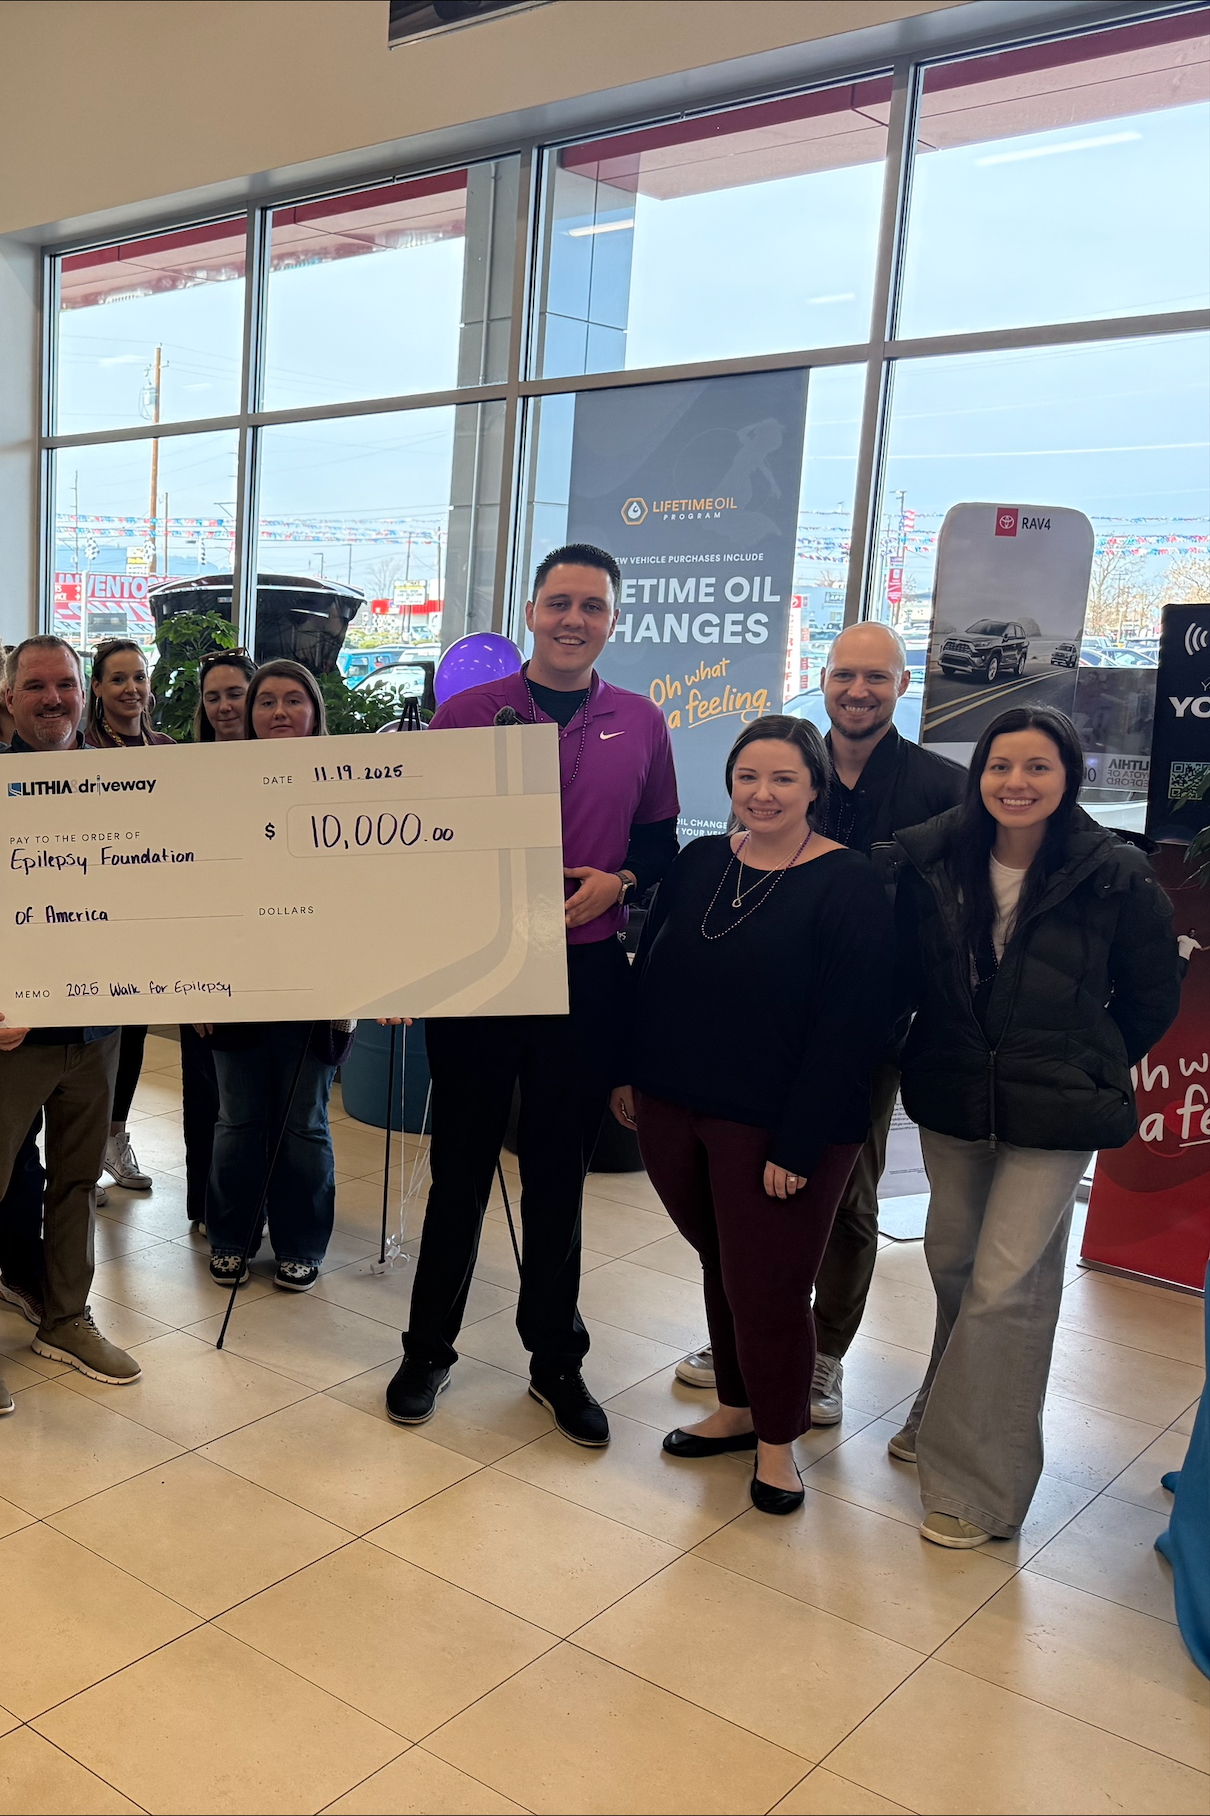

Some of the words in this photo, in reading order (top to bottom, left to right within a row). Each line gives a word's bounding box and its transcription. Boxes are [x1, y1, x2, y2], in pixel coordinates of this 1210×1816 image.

[663, 511, 721, 521] PROGRAM
[1021, 516, 1051, 531] RAV4
[615, 557, 628, 565] EW
[630, 555, 666, 565] VEHICLE
[668, 554, 721, 564] PURCHASES
[723, 552, 764, 562] INCLUDE
[620, 577, 716, 604] ETIME
[724, 576, 781, 603] OIL
[608, 612, 769, 645] HANGES
[650, 674, 682, 706] Oh
[685, 657, 730, 687] what
[668, 709, 681, 730] a
[262, 776, 293, 785] DATE
[9, 836, 30, 845] PAY
[35, 835, 49, 844] TO
[54, 834, 76, 843] THE
[81, 832, 120, 842] ORDER
[125, 831, 141, 840] OF
[264, 822, 276, 840] $
[10, 848, 88, 876] Epilepsy
[101, 846, 194, 866] Foundation
[45, 905, 109, 924] America
[258, 906, 314, 916] DOLLARS
[15, 989, 50, 999] MEMO
[109, 981, 141, 998] Walk
[149, 979, 168, 995] for
[174, 980, 232, 998] Epilepsy
[1139, 1112, 1165, 1142] a
